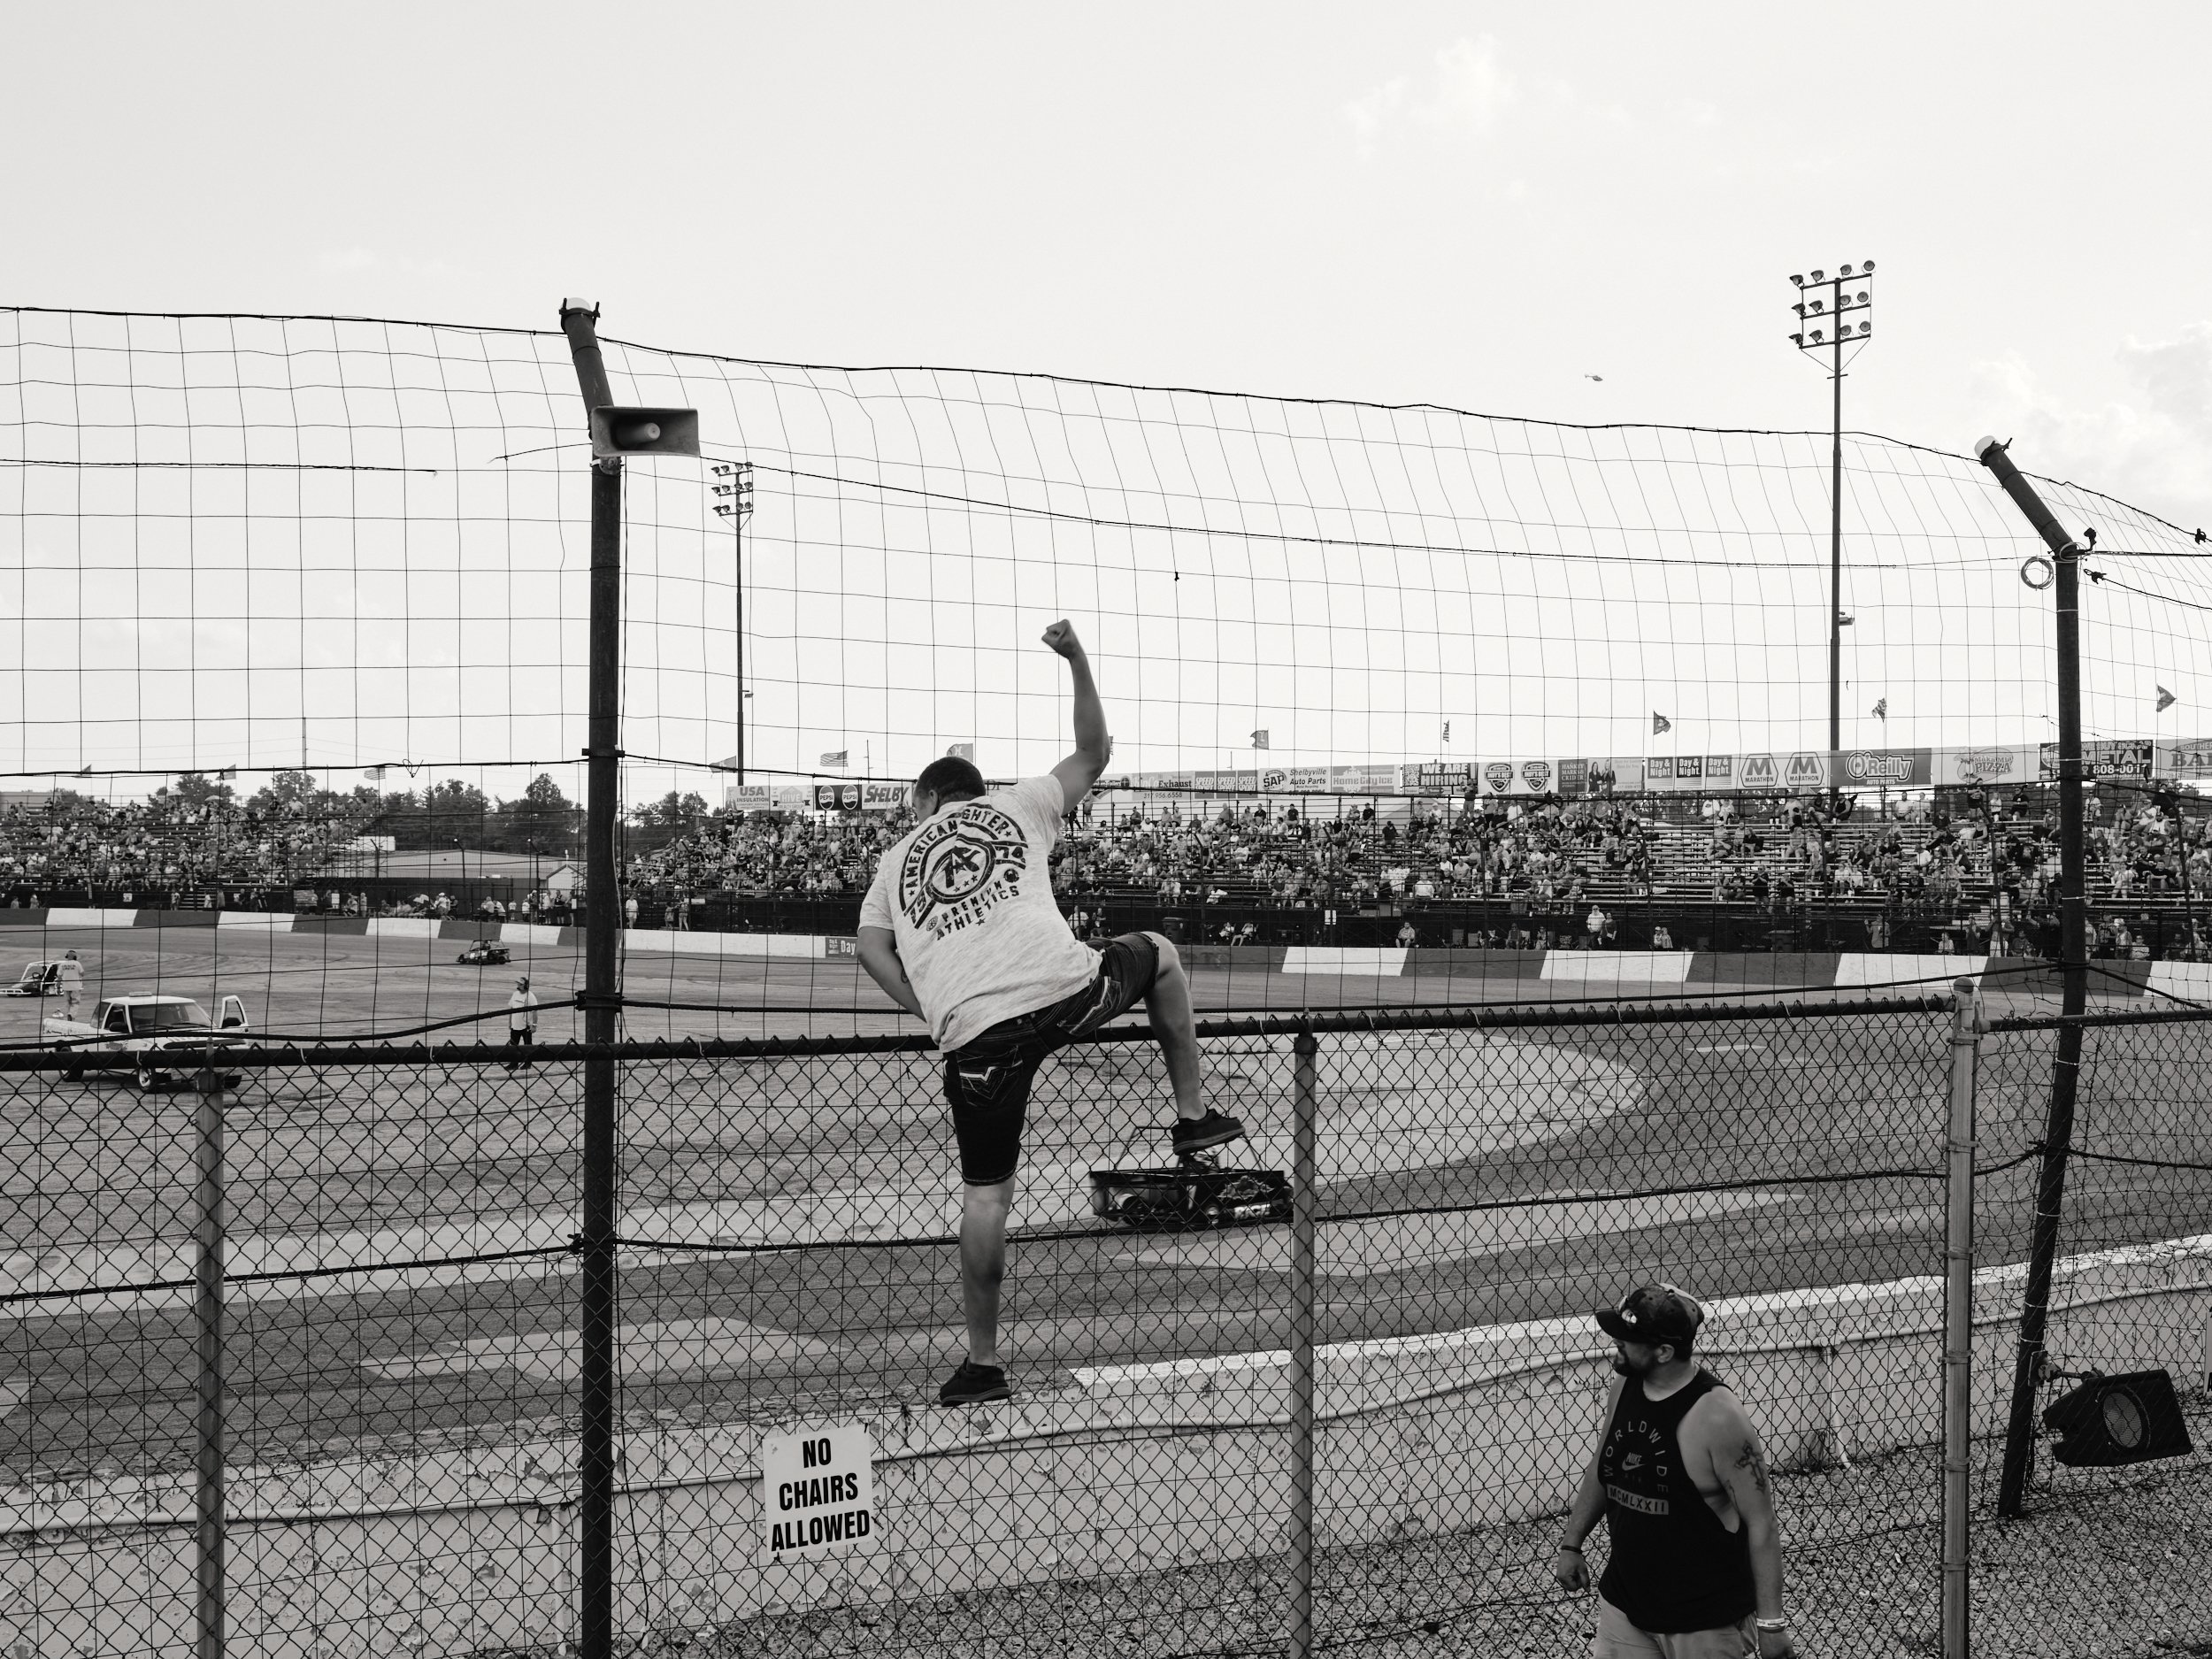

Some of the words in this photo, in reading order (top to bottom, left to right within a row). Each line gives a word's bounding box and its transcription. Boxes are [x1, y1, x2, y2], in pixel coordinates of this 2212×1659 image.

[1650, 759, 1663, 768] Day
[1679, 758, 1693, 767] Day
[1694, 757, 1700, 766] &
[1709, 757, 1722, 766] Day
[2082, 750, 2151, 764] METAL
[1289, 768, 1327, 777] Shelbyville
[1421, 764, 1441, 774] WE
[1443, 764, 1468, 774] ARE
[1848, 752, 1911, 780] O'Reilly
[1975, 762, 2011, 774] PIZZA
[1158, 779, 1193, 787] Exhaust
[1238, 776, 1256, 785] SPEED
[1263, 775, 1286, 787] SAP
[740, 787, 764, 795] USA
[864, 785, 910, 803] SHELBY
[781, 793, 802, 803] HIVE
[962, 809, 1009, 834] GHTER
[906, 819, 957, 888] AMERICAN
[936, 886, 1019, 941] ATHLETICS
[841, 940, 856, 956] Day
[802, 1437, 832, 1469] NO
[1603, 1420, 1669, 1494] WORLDWIDE
[1625, 1452, 1643, 1464] NIKE
[779, 1472, 858, 1511] CHAIRS
[1609, 1486, 1665, 1513] MCMLXXII
[771, 1509, 870, 1552] ALLOWED
